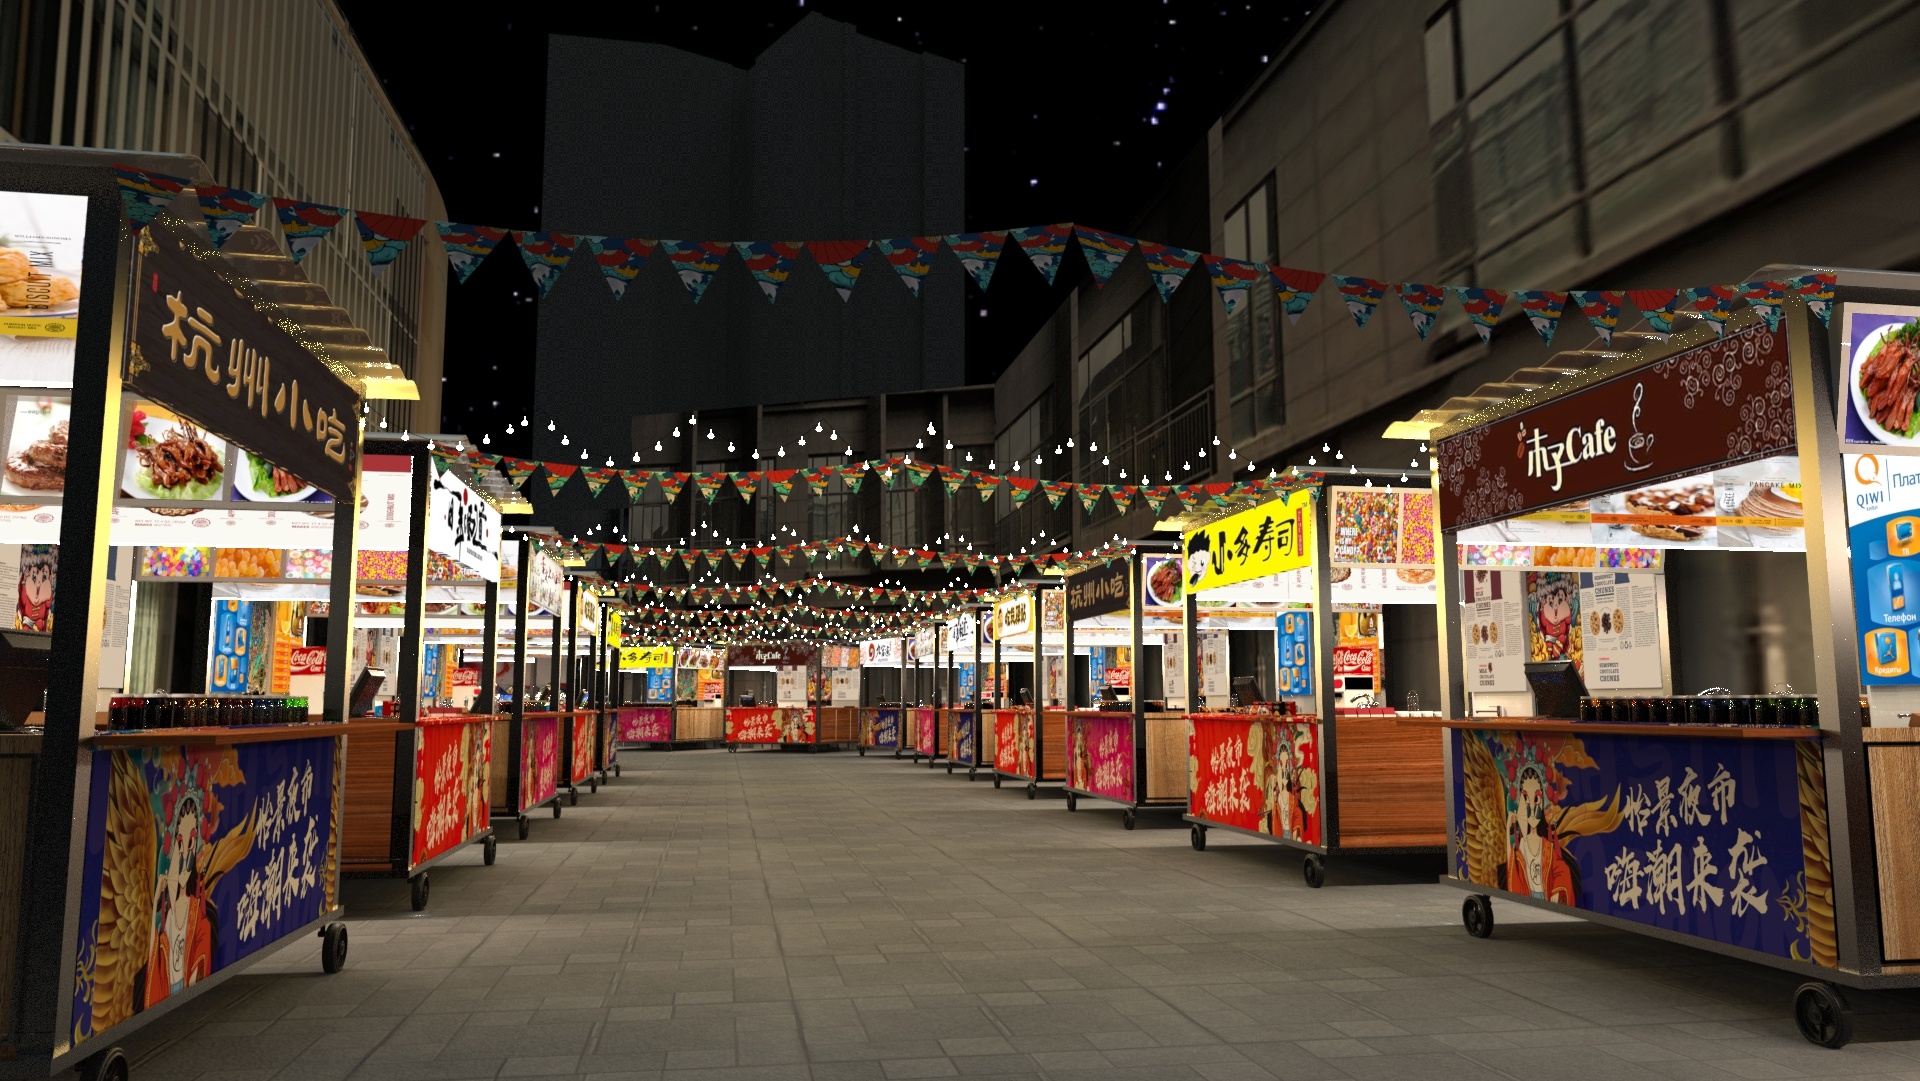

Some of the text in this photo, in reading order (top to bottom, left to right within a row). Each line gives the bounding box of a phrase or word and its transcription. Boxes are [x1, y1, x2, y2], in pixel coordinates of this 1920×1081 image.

[25, 250, 54, 309] BISCUIT MIX
[161, 290, 346, 464] 杭州小吃
[1749, 481, 1785, 489] PANCAKE
[1856, 490, 1884, 509] QIWI
[1212, 516, 1295, 576] 小多寿司
[1340, 527, 1359, 537] WHERE
[1901, 548, 1910, 556] ТВ
[1070, 572, 1125, 610] 杭州小吃
[1475, 601, 1491, 609] CHUNKS
[1594, 586, 1615, 595] CHUNKS
[1883, 612, 1917, 624] Телефон
[1874, 666, 1902, 675] Кредиты
[1210, 734, 1243, 775] 怡景夜市
[256, 759, 313, 850] 怡景夜市
[1204, 767, 1251, 816] 嗨潮来袭
[1624, 763, 1736, 837] 怡景夜市
[237, 814, 319, 942] 嗨潮来袭
[1604, 828, 1769, 917] 嗨潮来袭
